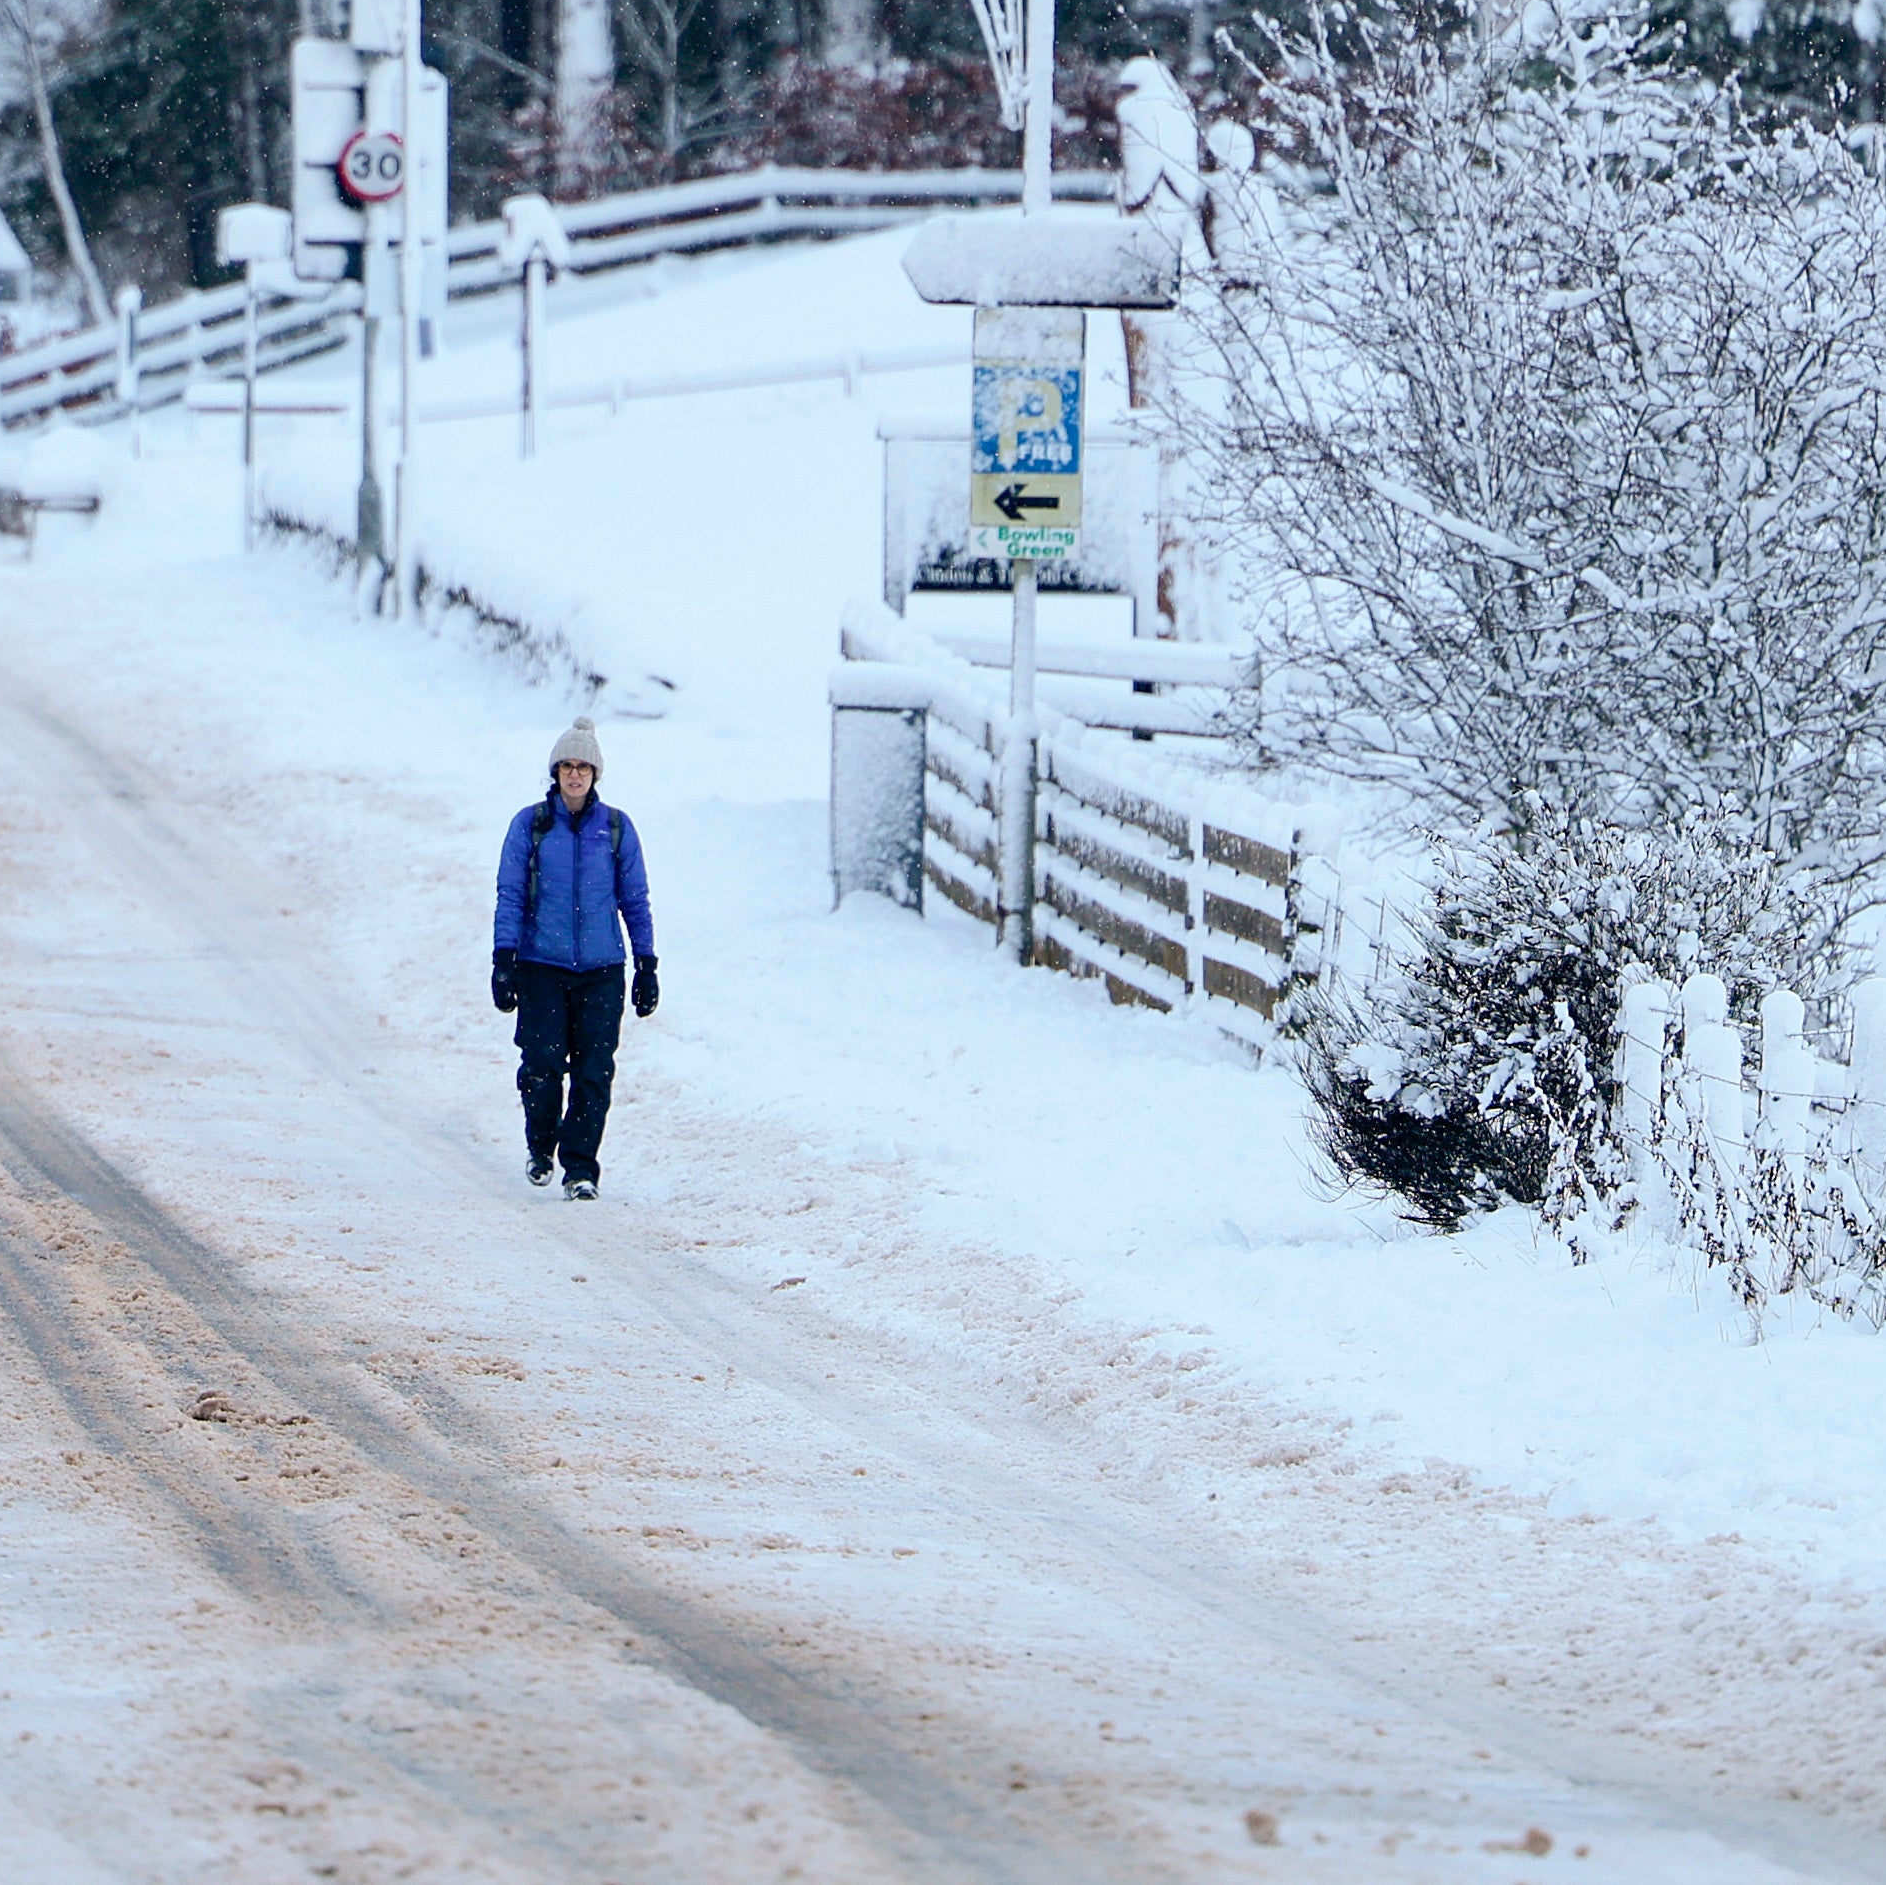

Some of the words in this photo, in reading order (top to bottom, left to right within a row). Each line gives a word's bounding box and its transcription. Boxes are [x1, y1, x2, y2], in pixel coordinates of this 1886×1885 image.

[351, 151, 401, 180] 30
[998, 379, 1062, 467] P
[998, 525, 1075, 545] Bowling
[1007, 542, 1065, 557] Green
